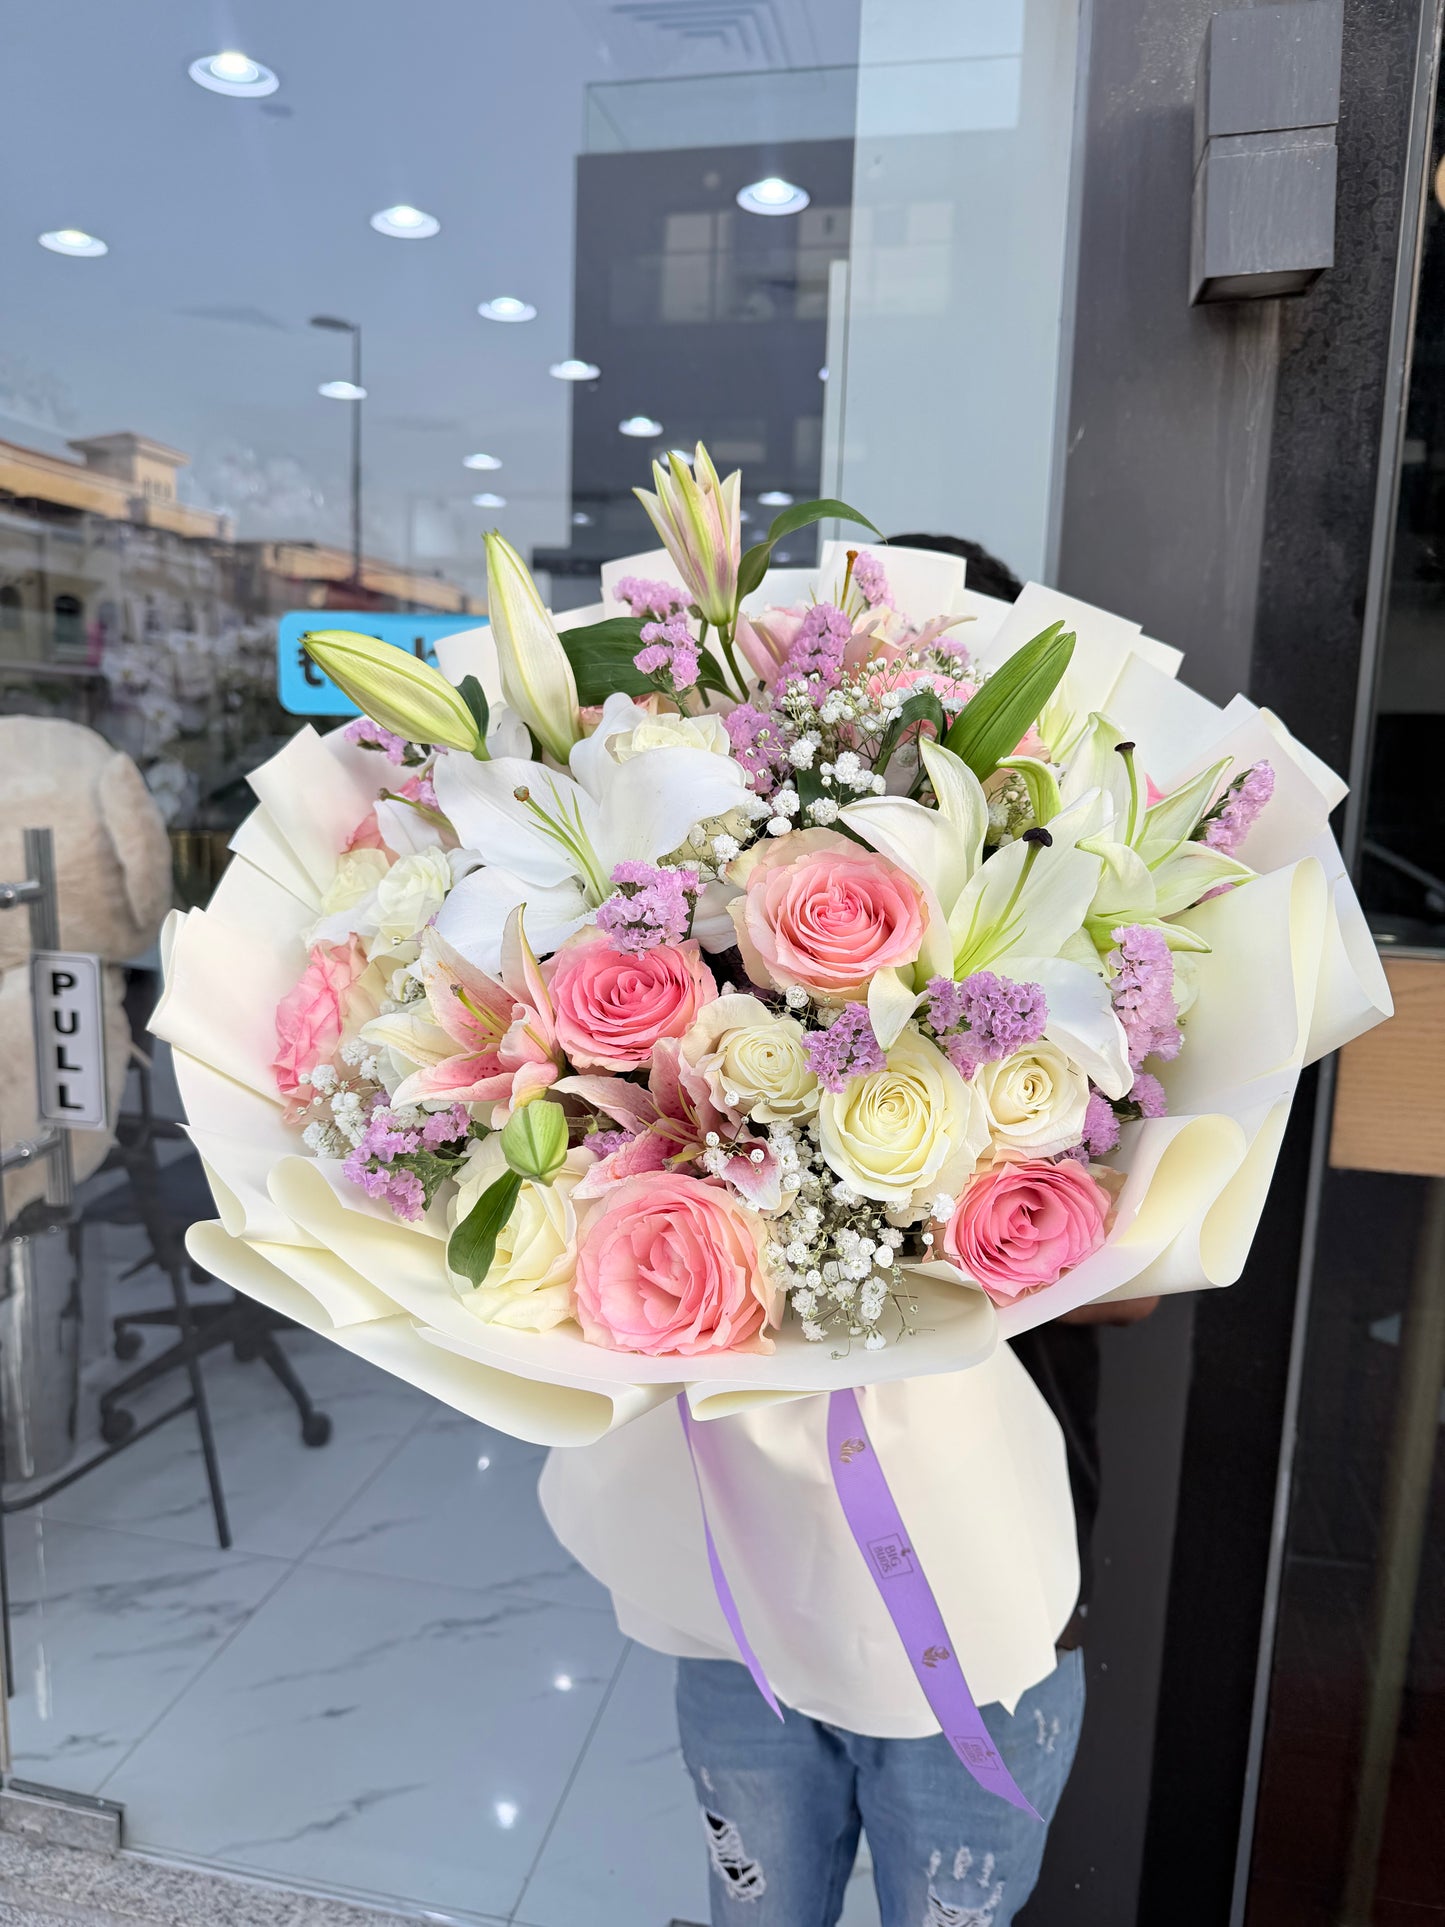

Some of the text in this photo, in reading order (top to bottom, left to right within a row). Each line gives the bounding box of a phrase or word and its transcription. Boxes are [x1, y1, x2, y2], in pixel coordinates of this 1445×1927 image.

[51, 972, 83, 1110] PULL
[874, 1545, 892, 1573] BUDS
[885, 1544, 902, 1567] BIG
